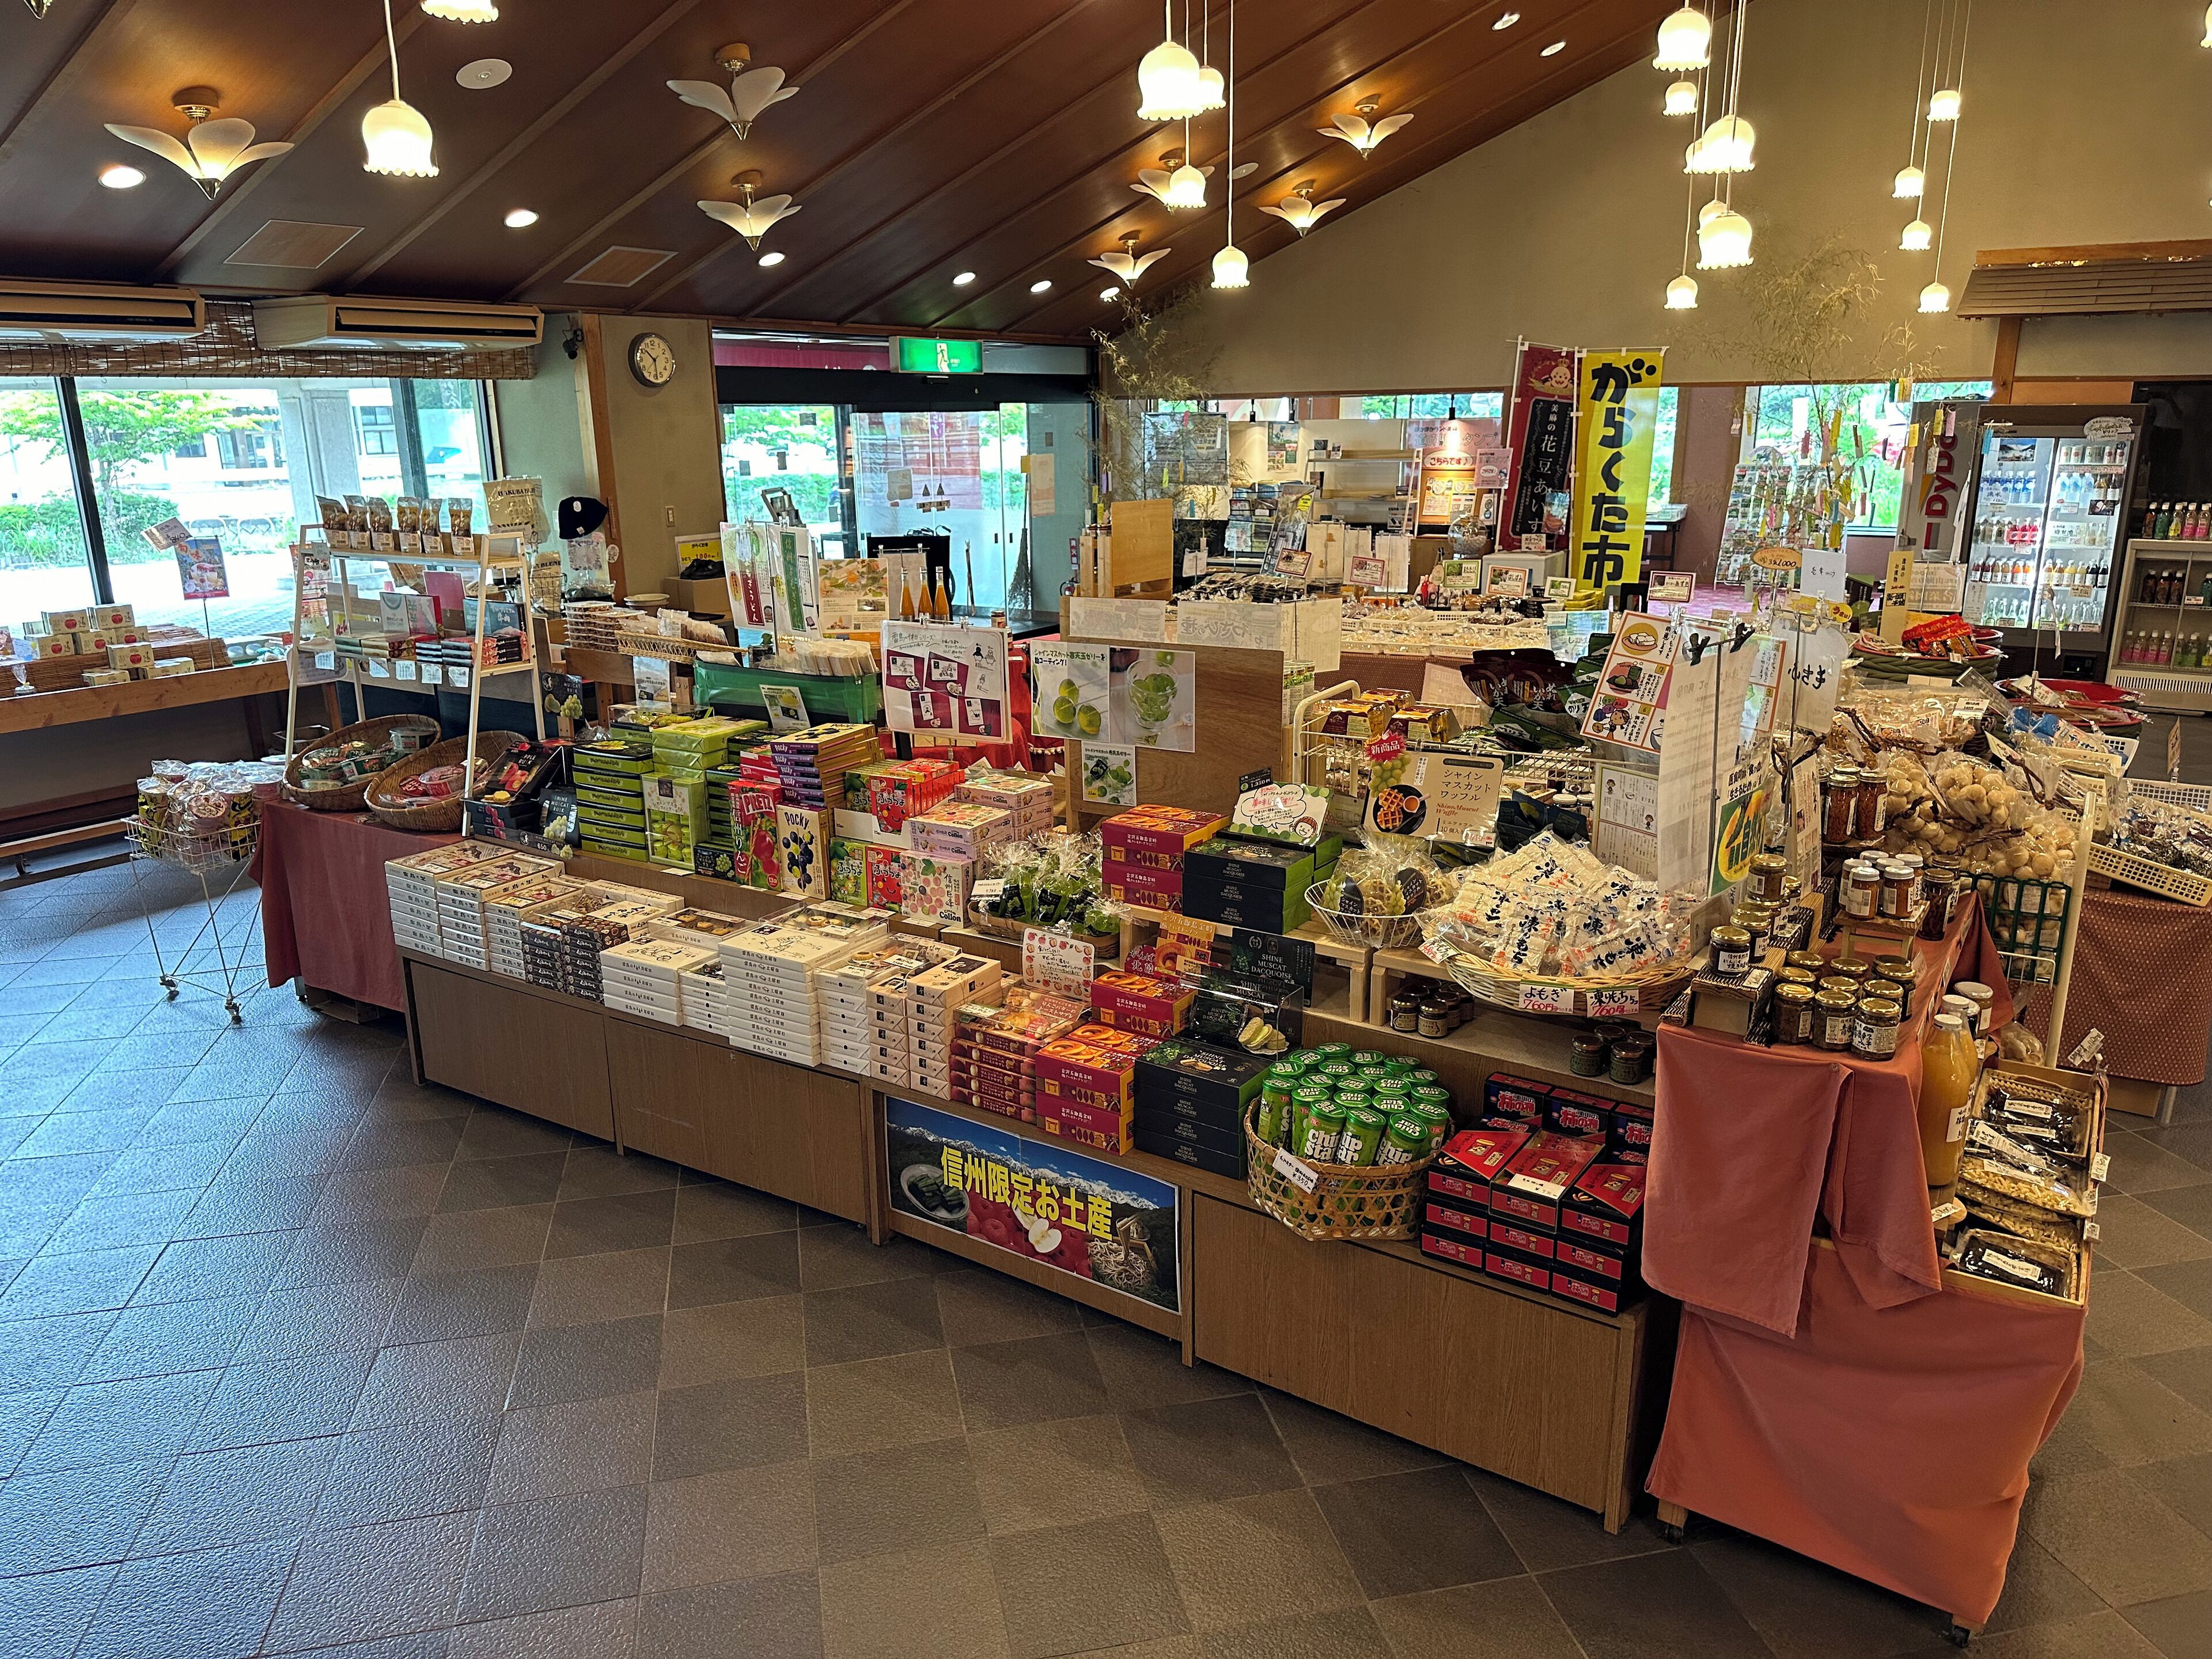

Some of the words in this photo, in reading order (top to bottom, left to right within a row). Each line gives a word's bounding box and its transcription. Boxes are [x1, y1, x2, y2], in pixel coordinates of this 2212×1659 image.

[1582, 358, 1657, 589] がらくた市
[1489, 683, 1507, 707] いか天
[1532, 685, 1546, 711] いか天
[774, 744, 788, 753] Pocky
[1371, 741, 1400, 755] 新商品
[775, 755, 787, 764] Pocky
[781, 766, 793, 775] Pocky
[1444, 770, 1483, 780] シャイン
[783, 777, 796, 786] Pocky
[1442, 781, 1491, 793] マスカット
[1441, 790, 1480, 801] ワッフル
[744, 793, 773, 813] PRETZ
[785, 811, 809, 830] Pocky
[732, 809, 747, 874] 信州りんご
[948, 831, 963, 839] Collon
[940, 912, 961, 923] Collon
[1258, 960, 1287, 971] MUSCAT
[1262, 953, 1283, 964] SHINE
[1132, 960, 1154, 975] 北陸
[1251, 966, 1293, 980] DACQUOISE
[1524, 986, 1567, 1002] よもぎ
[1590, 989, 1629, 1006] 凍りもち
[1523, 999, 1554, 1011] 760円
[1592, 1005, 1625, 1017] 760円
[1308, 1128, 1340, 1149] Chi
[1305, 1141, 1337, 1163] Sta
[941, 1145, 1113, 1242] 信州限定お土産
